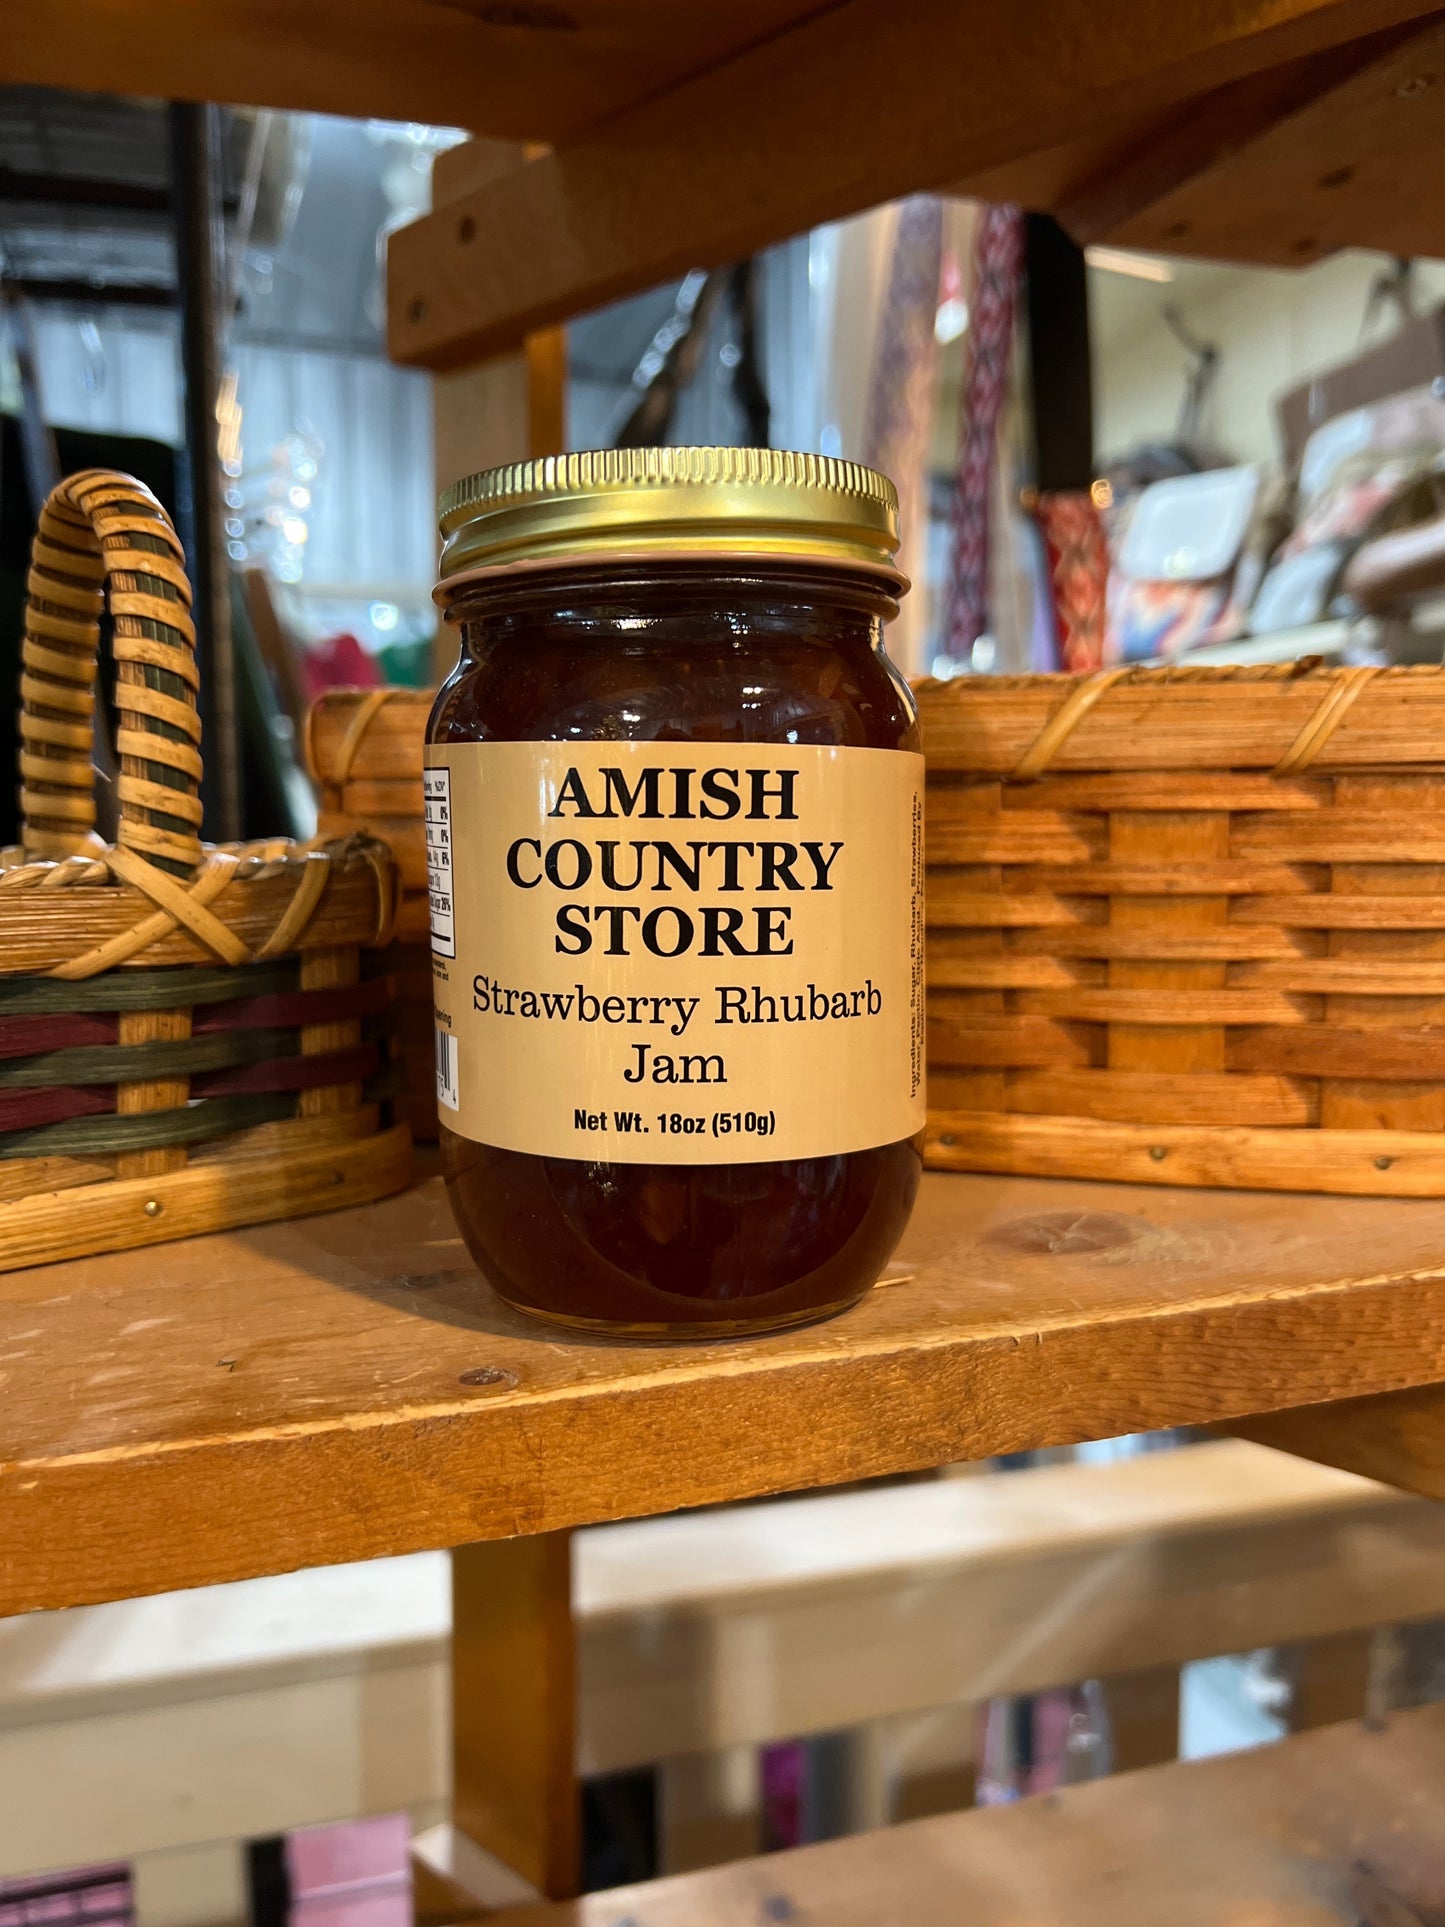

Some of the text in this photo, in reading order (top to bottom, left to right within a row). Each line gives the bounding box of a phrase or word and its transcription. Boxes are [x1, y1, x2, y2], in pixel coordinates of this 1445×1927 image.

[548, 768, 799, 820] AMISH
[507, 838, 844, 891] COUNTRY
[556, 905, 793, 957] STORE
[473, 975, 881, 1035] Strawberry Rhubarb
[624, 1044, 727, 1083] Jam
[575, 1109, 775, 1137] Net Wt. 18oz (510g)
